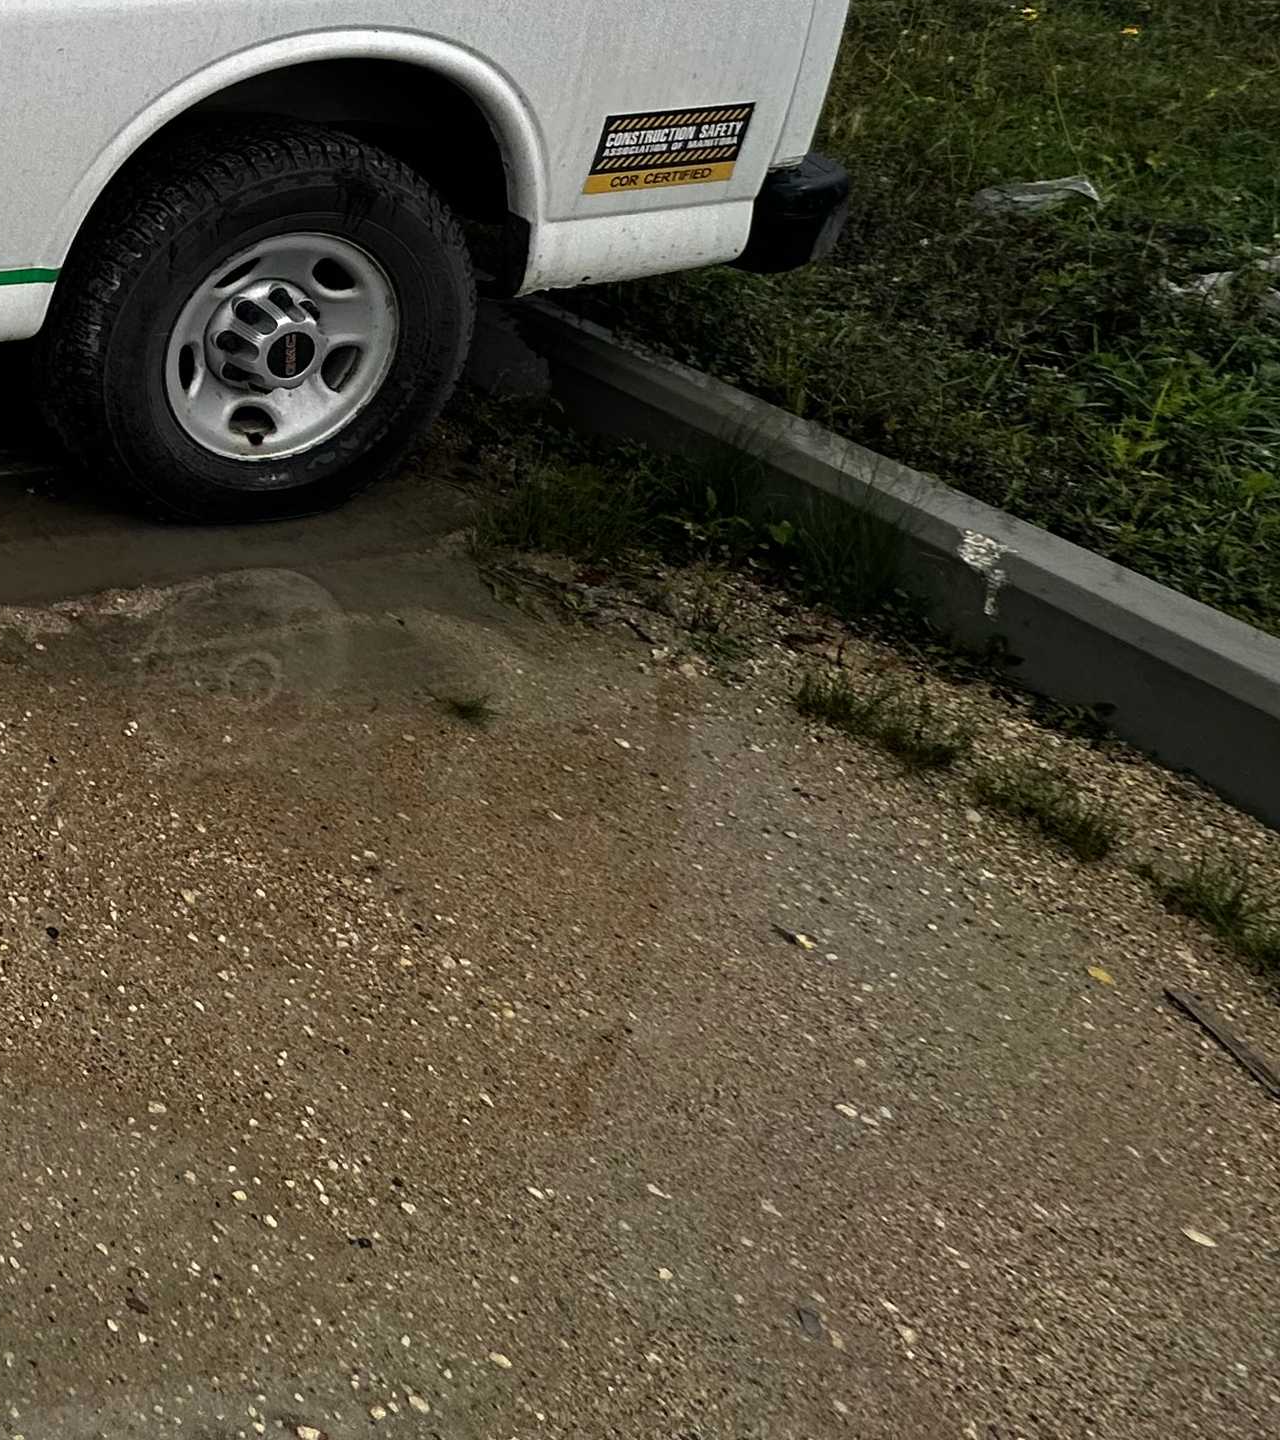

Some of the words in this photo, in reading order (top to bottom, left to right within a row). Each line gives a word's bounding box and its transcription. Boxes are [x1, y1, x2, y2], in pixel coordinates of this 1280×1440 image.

[605, 126, 696, 148] CONSTRUCTION
[698, 121, 744, 139] SAFETY
[602, 143, 667, 157] ASSOCIATION
[670, 141, 684, 151] OF
[610, 175, 639, 188] COR
[643, 168, 712, 185] CERTIFIED
[285, 333, 297, 376] GMC
